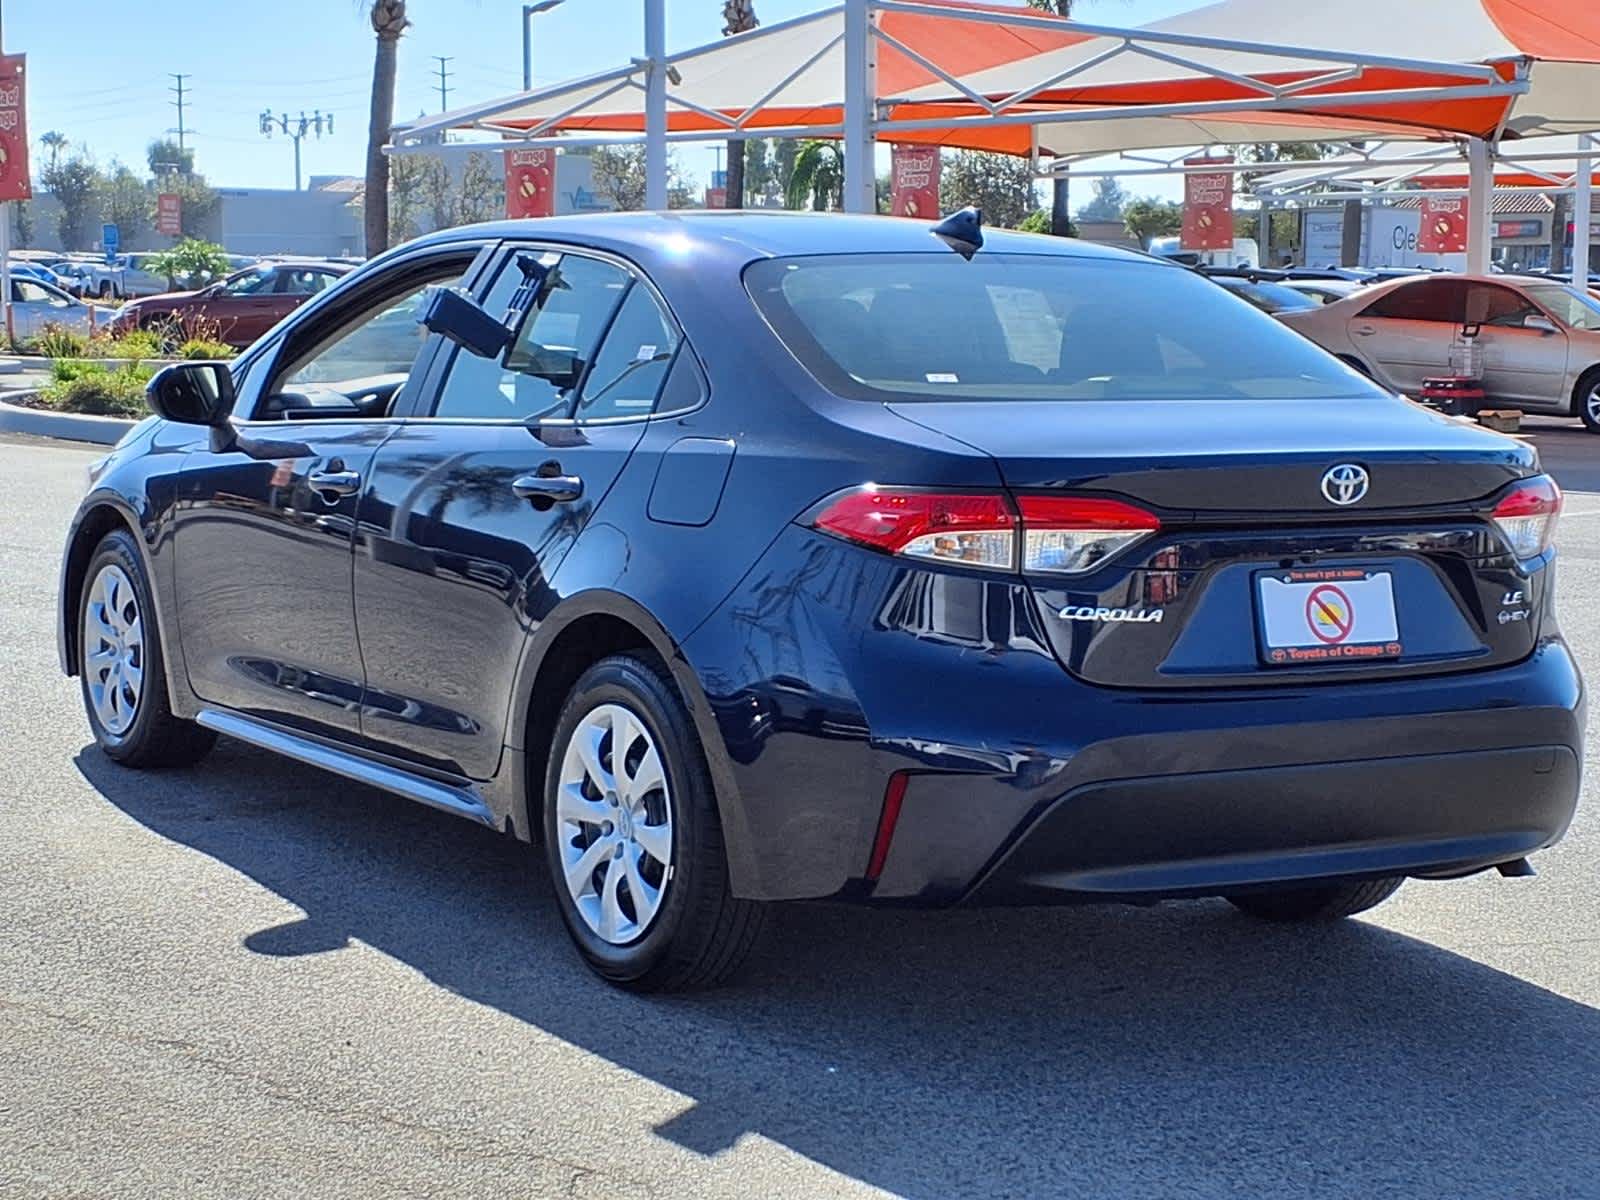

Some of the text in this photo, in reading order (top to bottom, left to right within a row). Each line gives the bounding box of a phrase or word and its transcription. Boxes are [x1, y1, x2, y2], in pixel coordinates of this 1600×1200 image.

[896, 156, 933, 174] Toyota of
[899, 173, 929, 189] Orange
[1428, 199, 1461, 213] Orange
[1393, 225, 1416, 250] Cle
[1502, 591, 1523, 605] LE
[1059, 605, 1165, 622] COROLLA
[1287, 644, 1384, 659] Toyota of Orange
